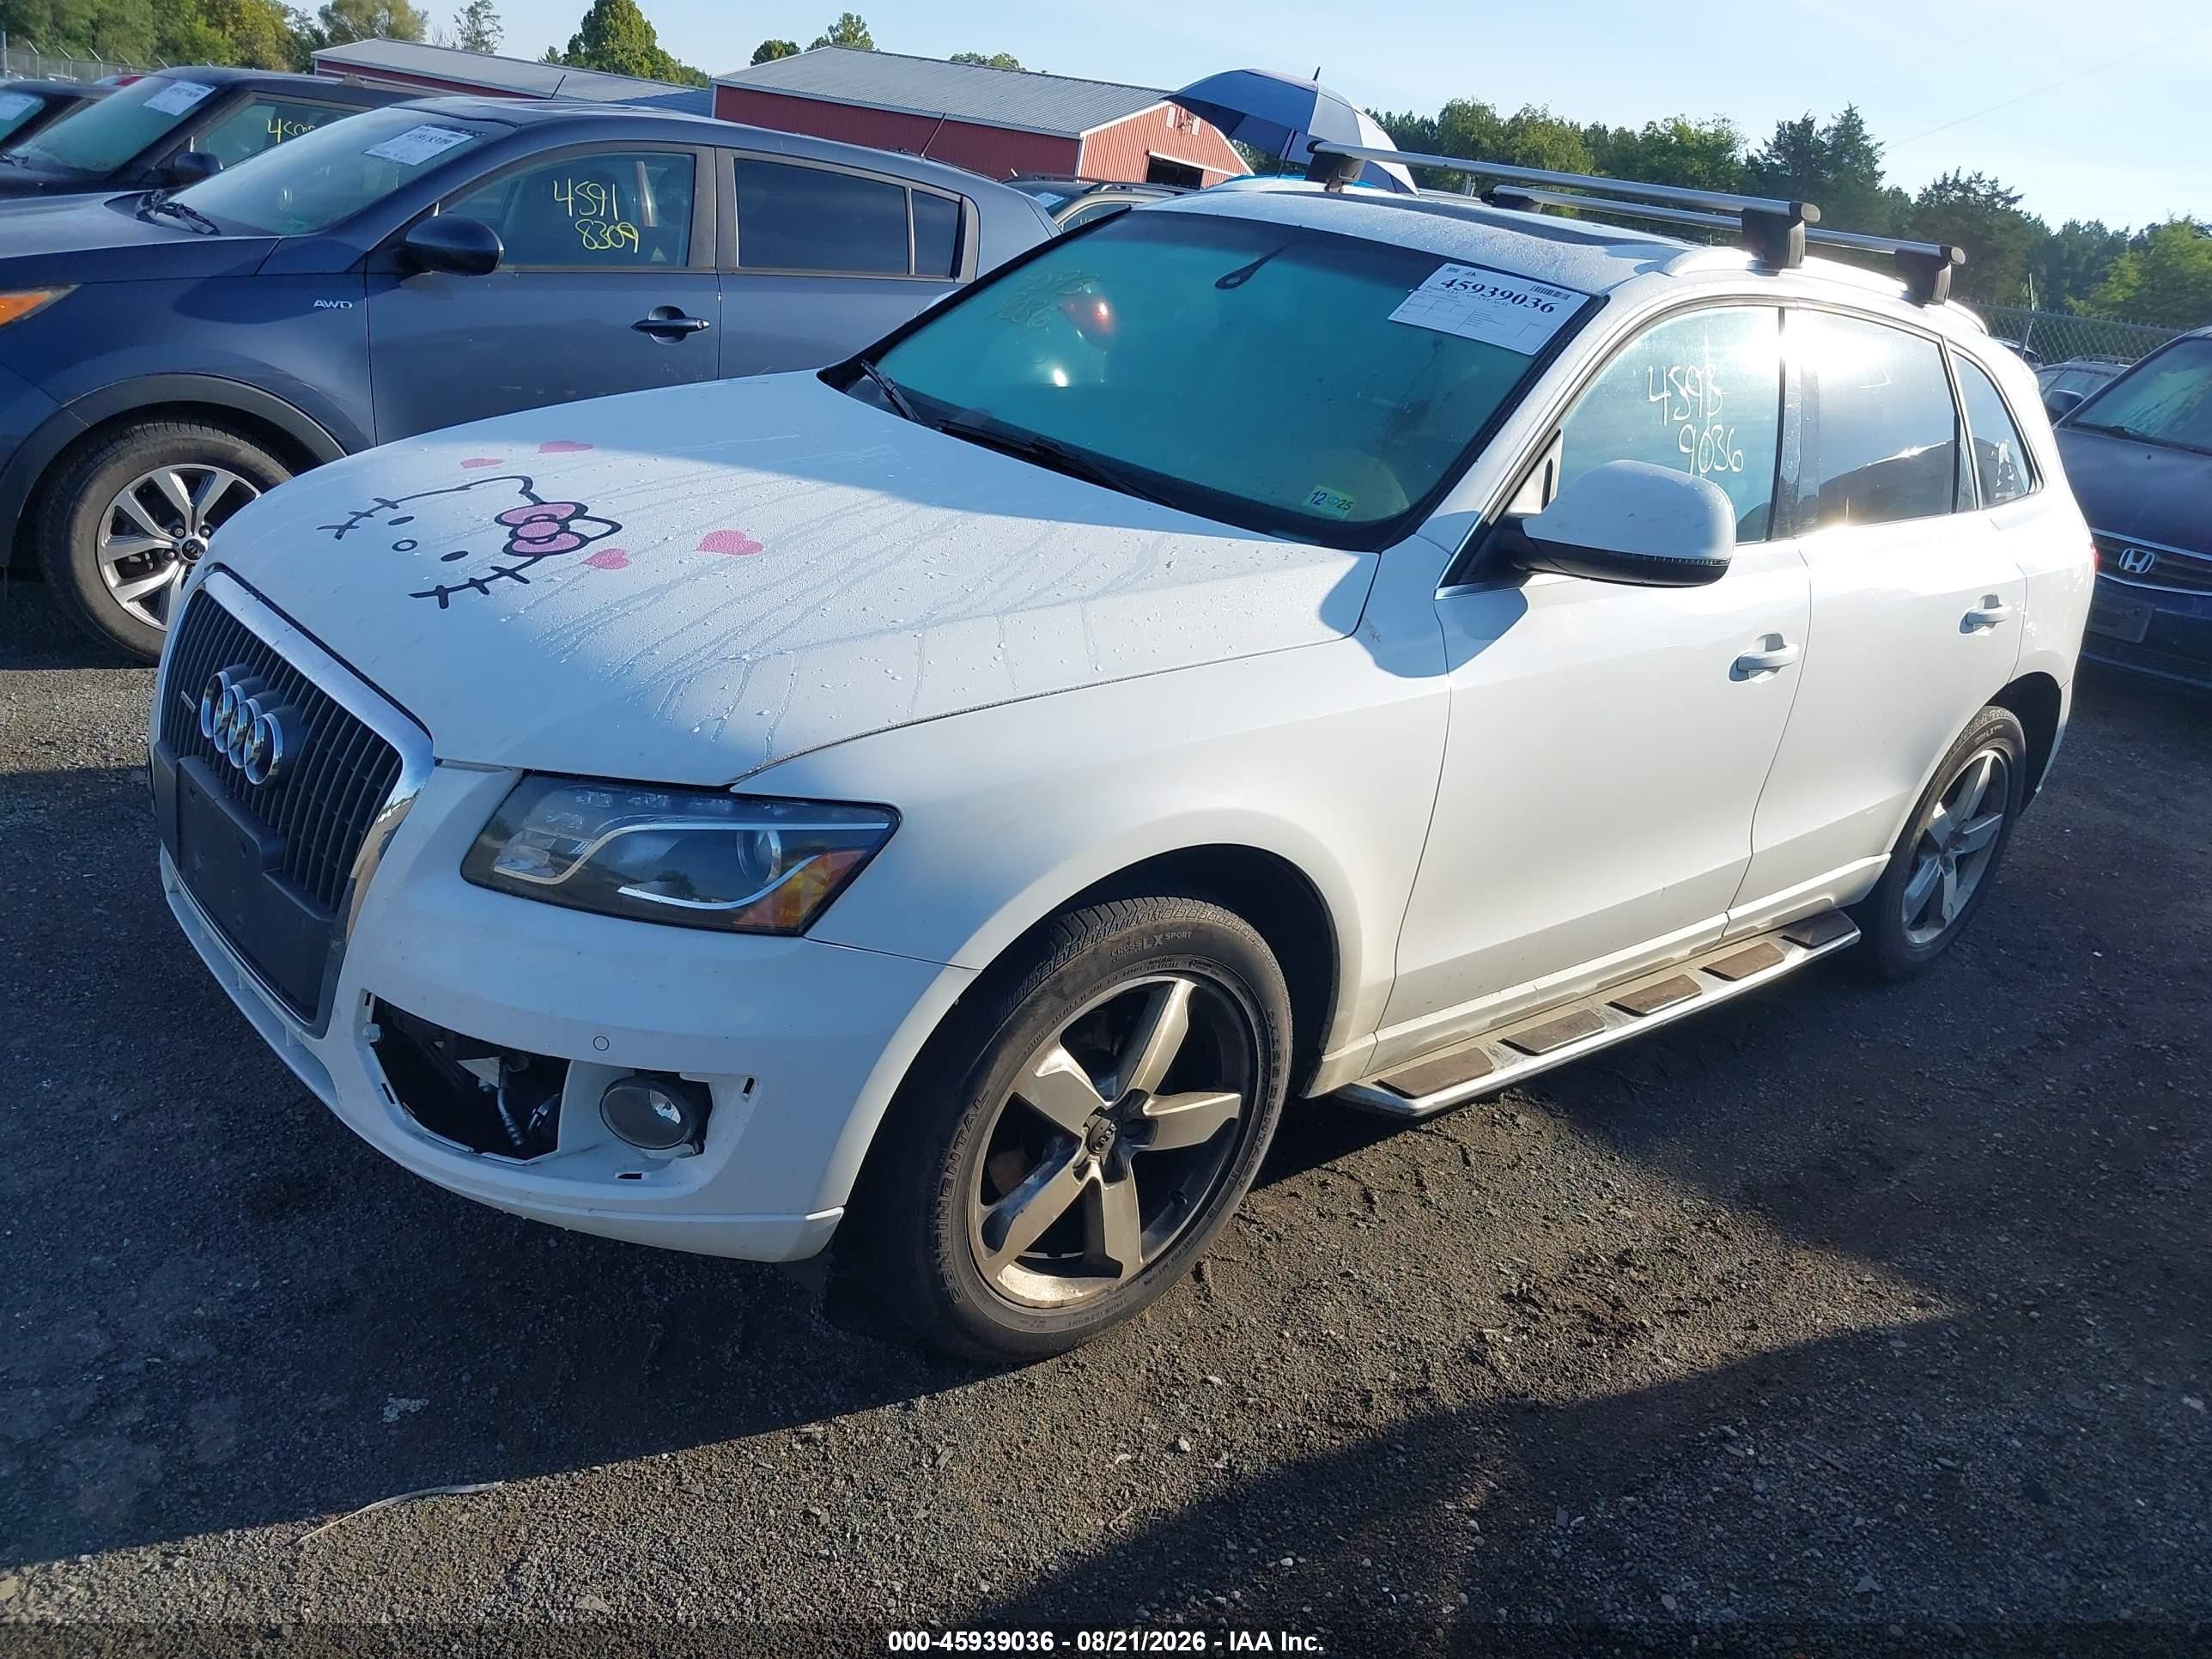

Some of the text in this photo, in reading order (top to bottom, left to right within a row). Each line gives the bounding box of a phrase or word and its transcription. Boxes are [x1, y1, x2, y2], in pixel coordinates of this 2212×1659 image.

[553, 178, 618, 218] 4591
[574, 218, 639, 254] 8309
[313, 300, 353, 309] AWD
[1440, 277, 1557, 314] 45939036
[1678, 423, 1744, 475] 9036
[1310, 490, 1328, 506] 12
[1164, 931, 1194, 940] SPORT
[934, 1090, 989, 1304] CONTINENTAL
